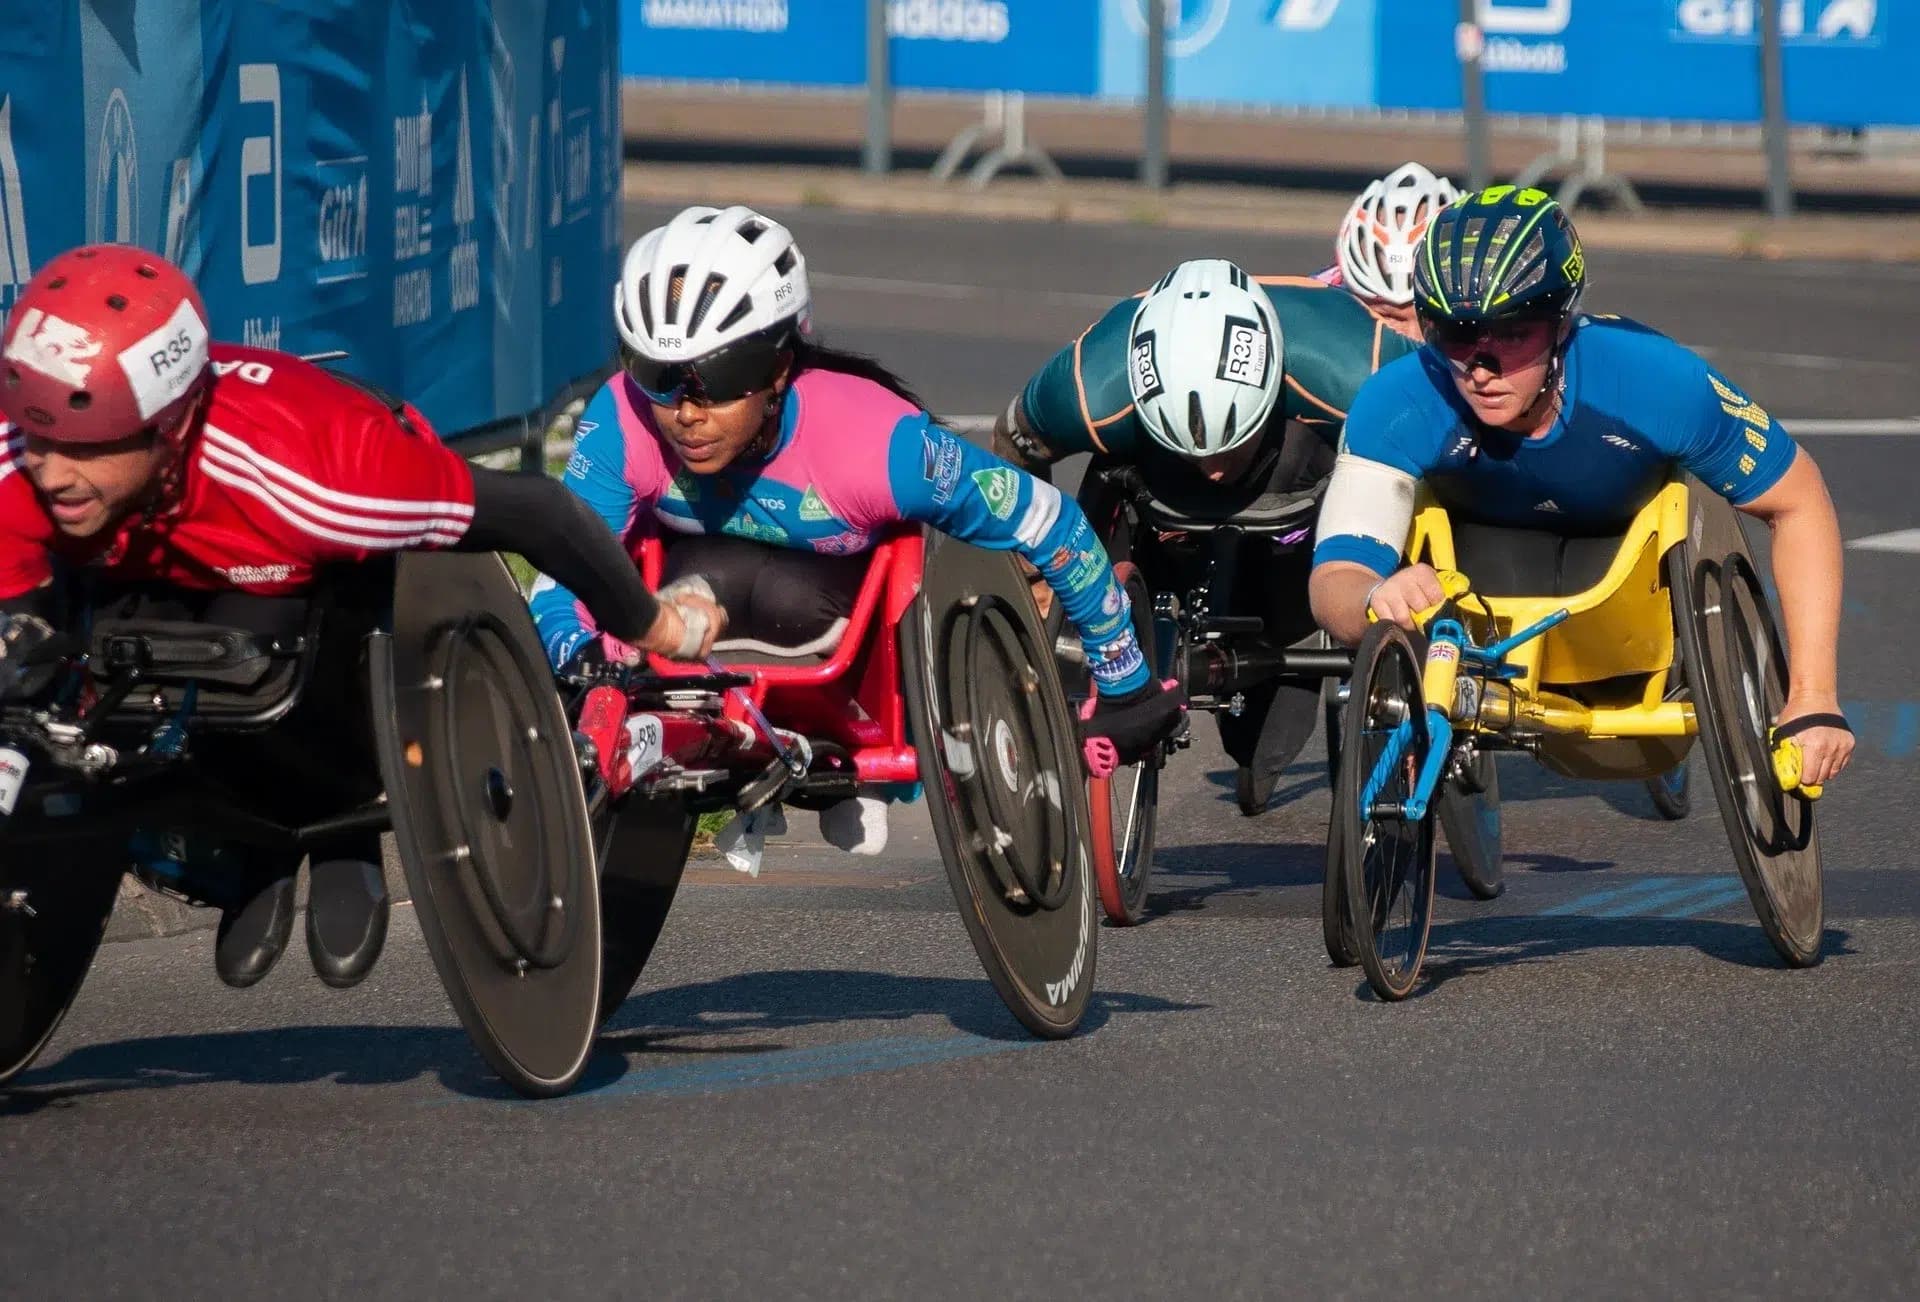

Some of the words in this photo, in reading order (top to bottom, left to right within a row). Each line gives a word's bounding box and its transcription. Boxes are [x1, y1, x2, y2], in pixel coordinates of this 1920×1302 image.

[774, 282, 794, 301] RF8
[150, 328, 192, 377] R35
[658, 337, 682, 348] RF8
[1138, 342, 1156, 388] R30
